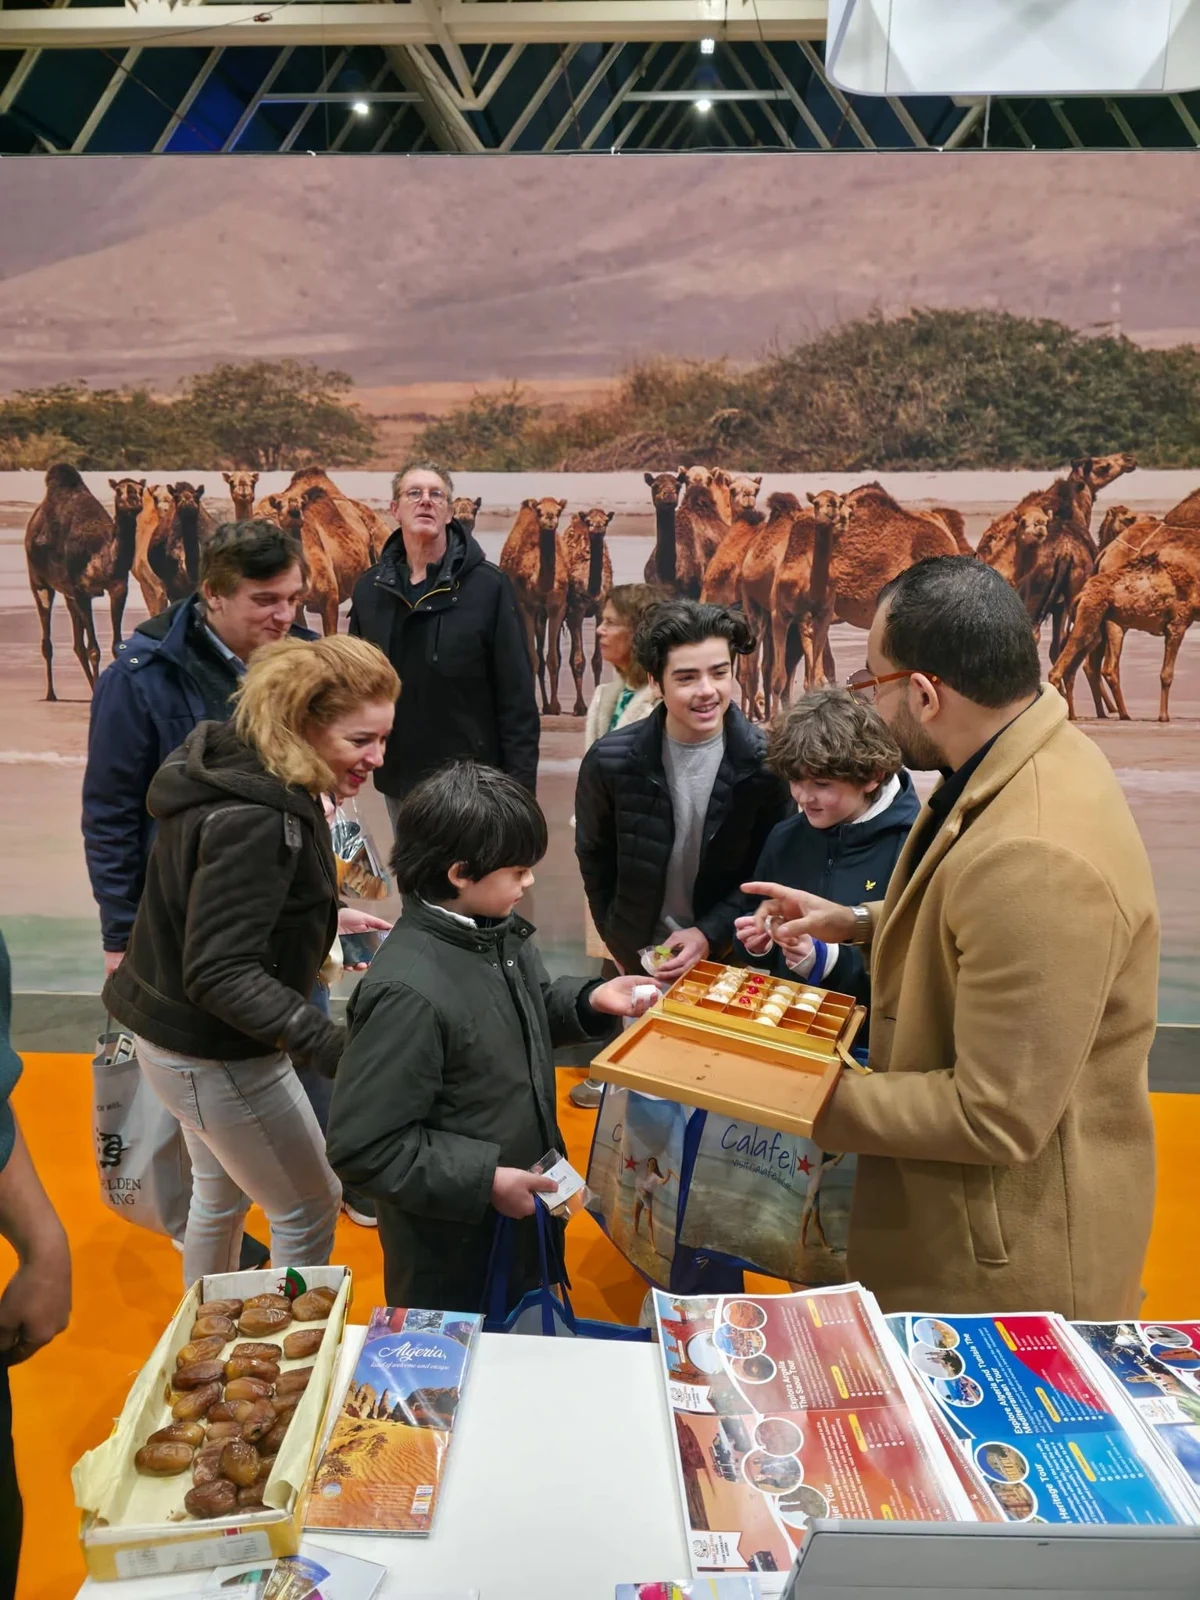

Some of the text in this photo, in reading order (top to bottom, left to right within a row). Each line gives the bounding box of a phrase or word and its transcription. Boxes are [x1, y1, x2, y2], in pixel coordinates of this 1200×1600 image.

[722, 1124, 797, 1177] Calafell
[788, 1360, 797, 1374] Tour
[963, 1333, 1023, 1433] Explore Algeria and Tunisia The
[786, 1384, 799, 1409] Explora
[799, 1396, 808, 1408] The
[991, 1367, 1032, 1433] Mediterranean Tour
[825, 1484, 836, 1502] Tour
[1035, 1464, 1070, 1519] Heritage Tour
